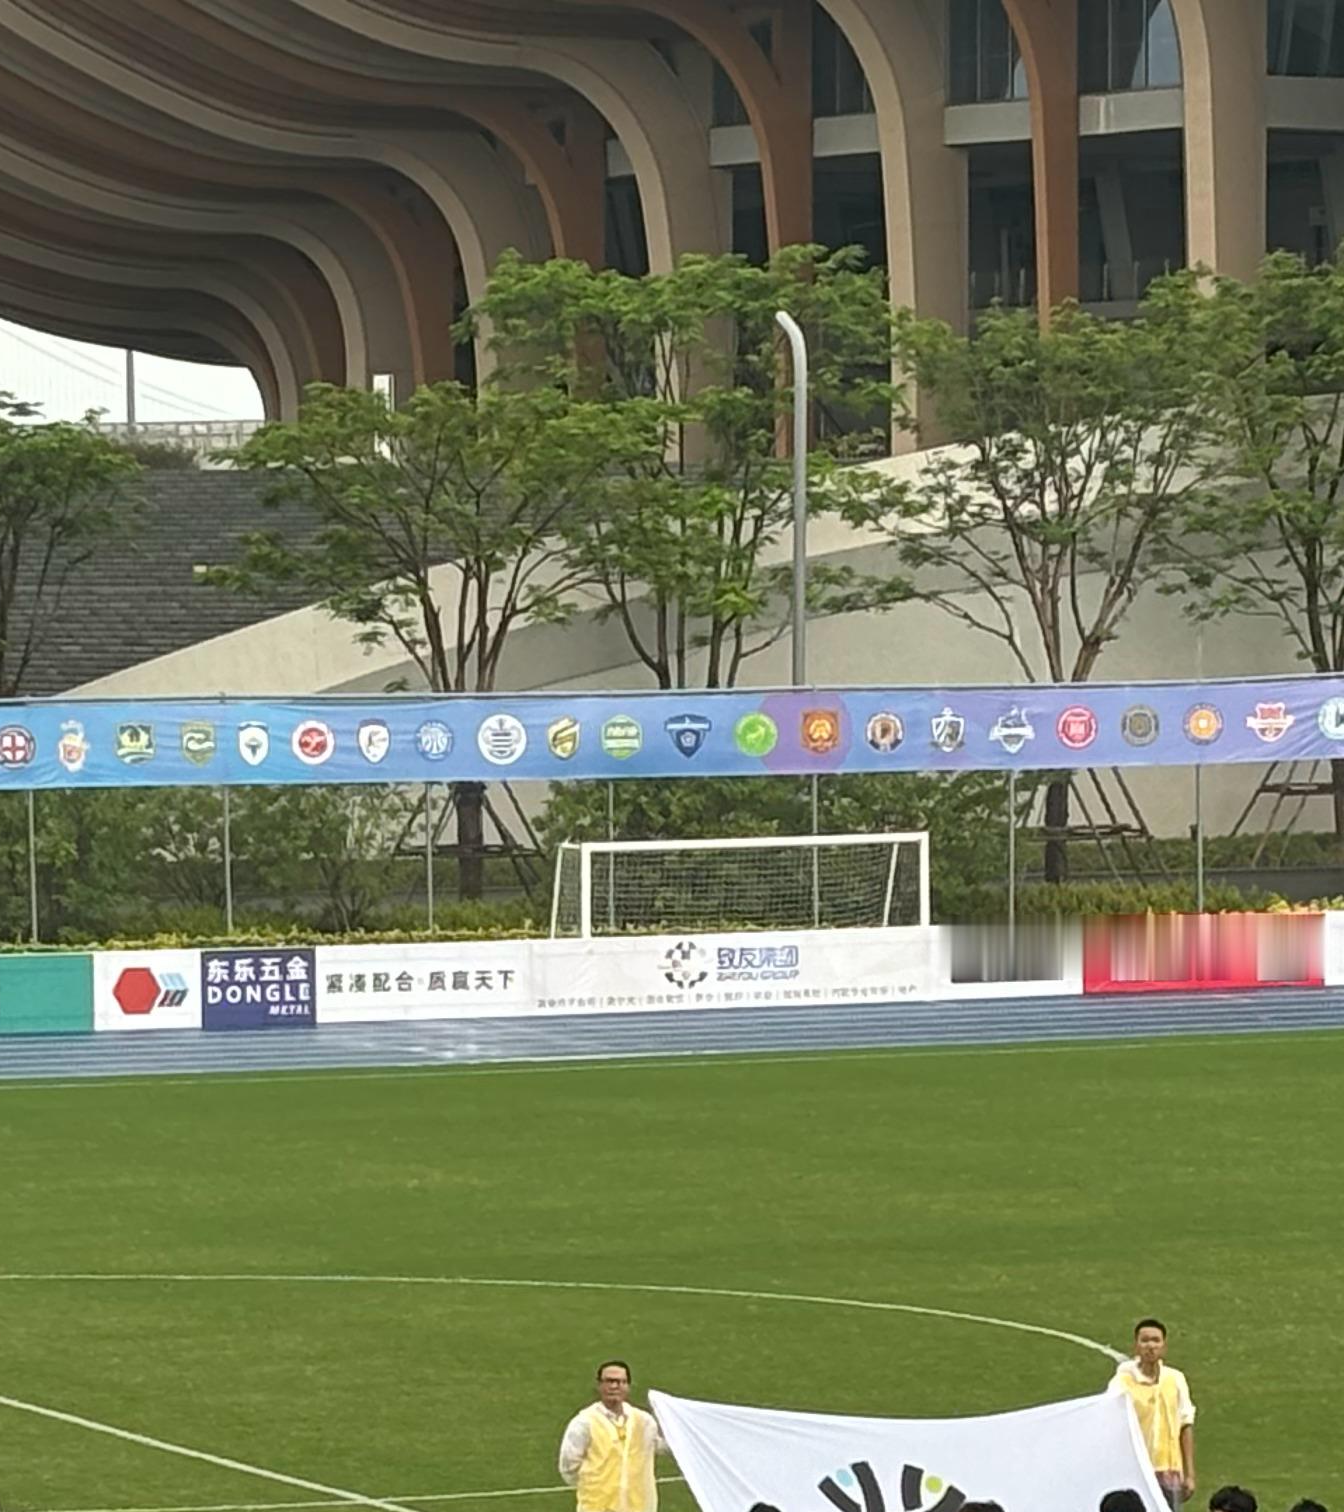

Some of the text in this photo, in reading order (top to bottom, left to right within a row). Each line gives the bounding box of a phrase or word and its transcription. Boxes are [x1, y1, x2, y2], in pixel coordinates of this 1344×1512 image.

[207, 956, 309, 984] 东乐五金
[207, 983, 311, 1004] DONGLE
